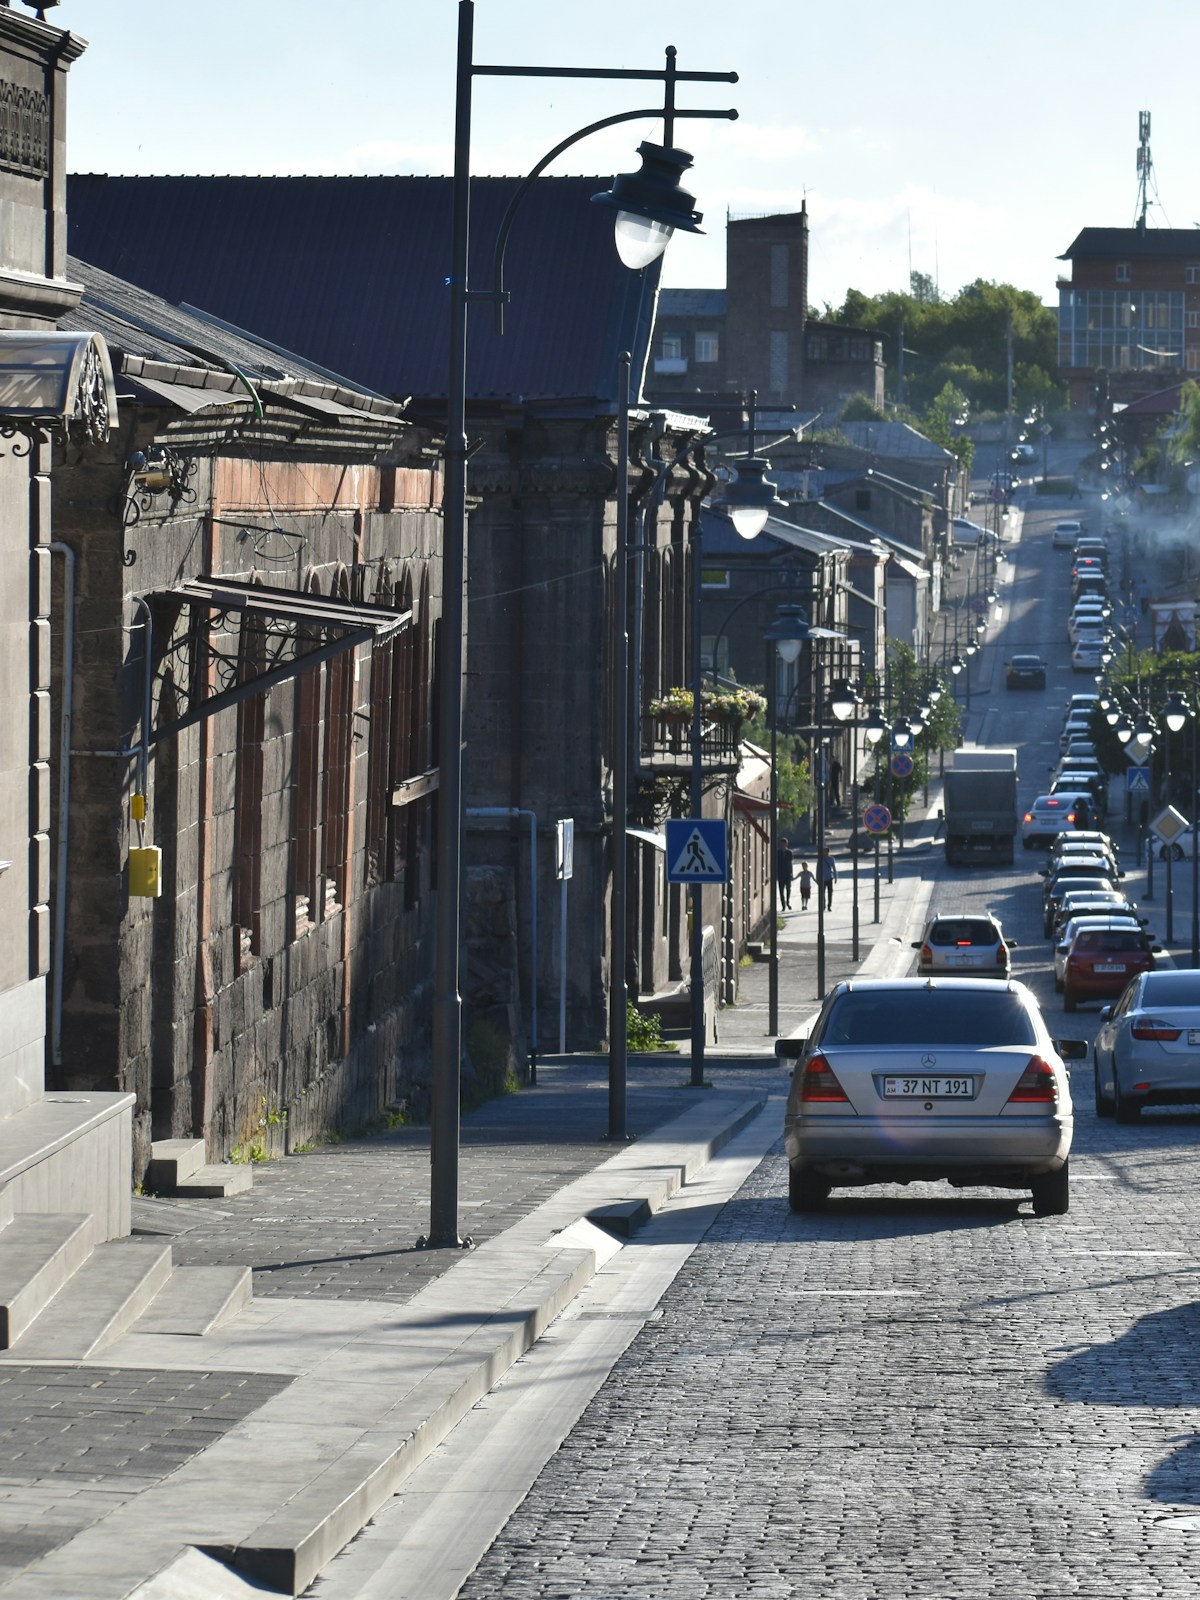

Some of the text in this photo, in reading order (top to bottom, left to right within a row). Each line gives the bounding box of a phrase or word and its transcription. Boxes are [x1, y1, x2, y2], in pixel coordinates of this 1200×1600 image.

[903, 1080, 969, 1093] 37 NT 191
